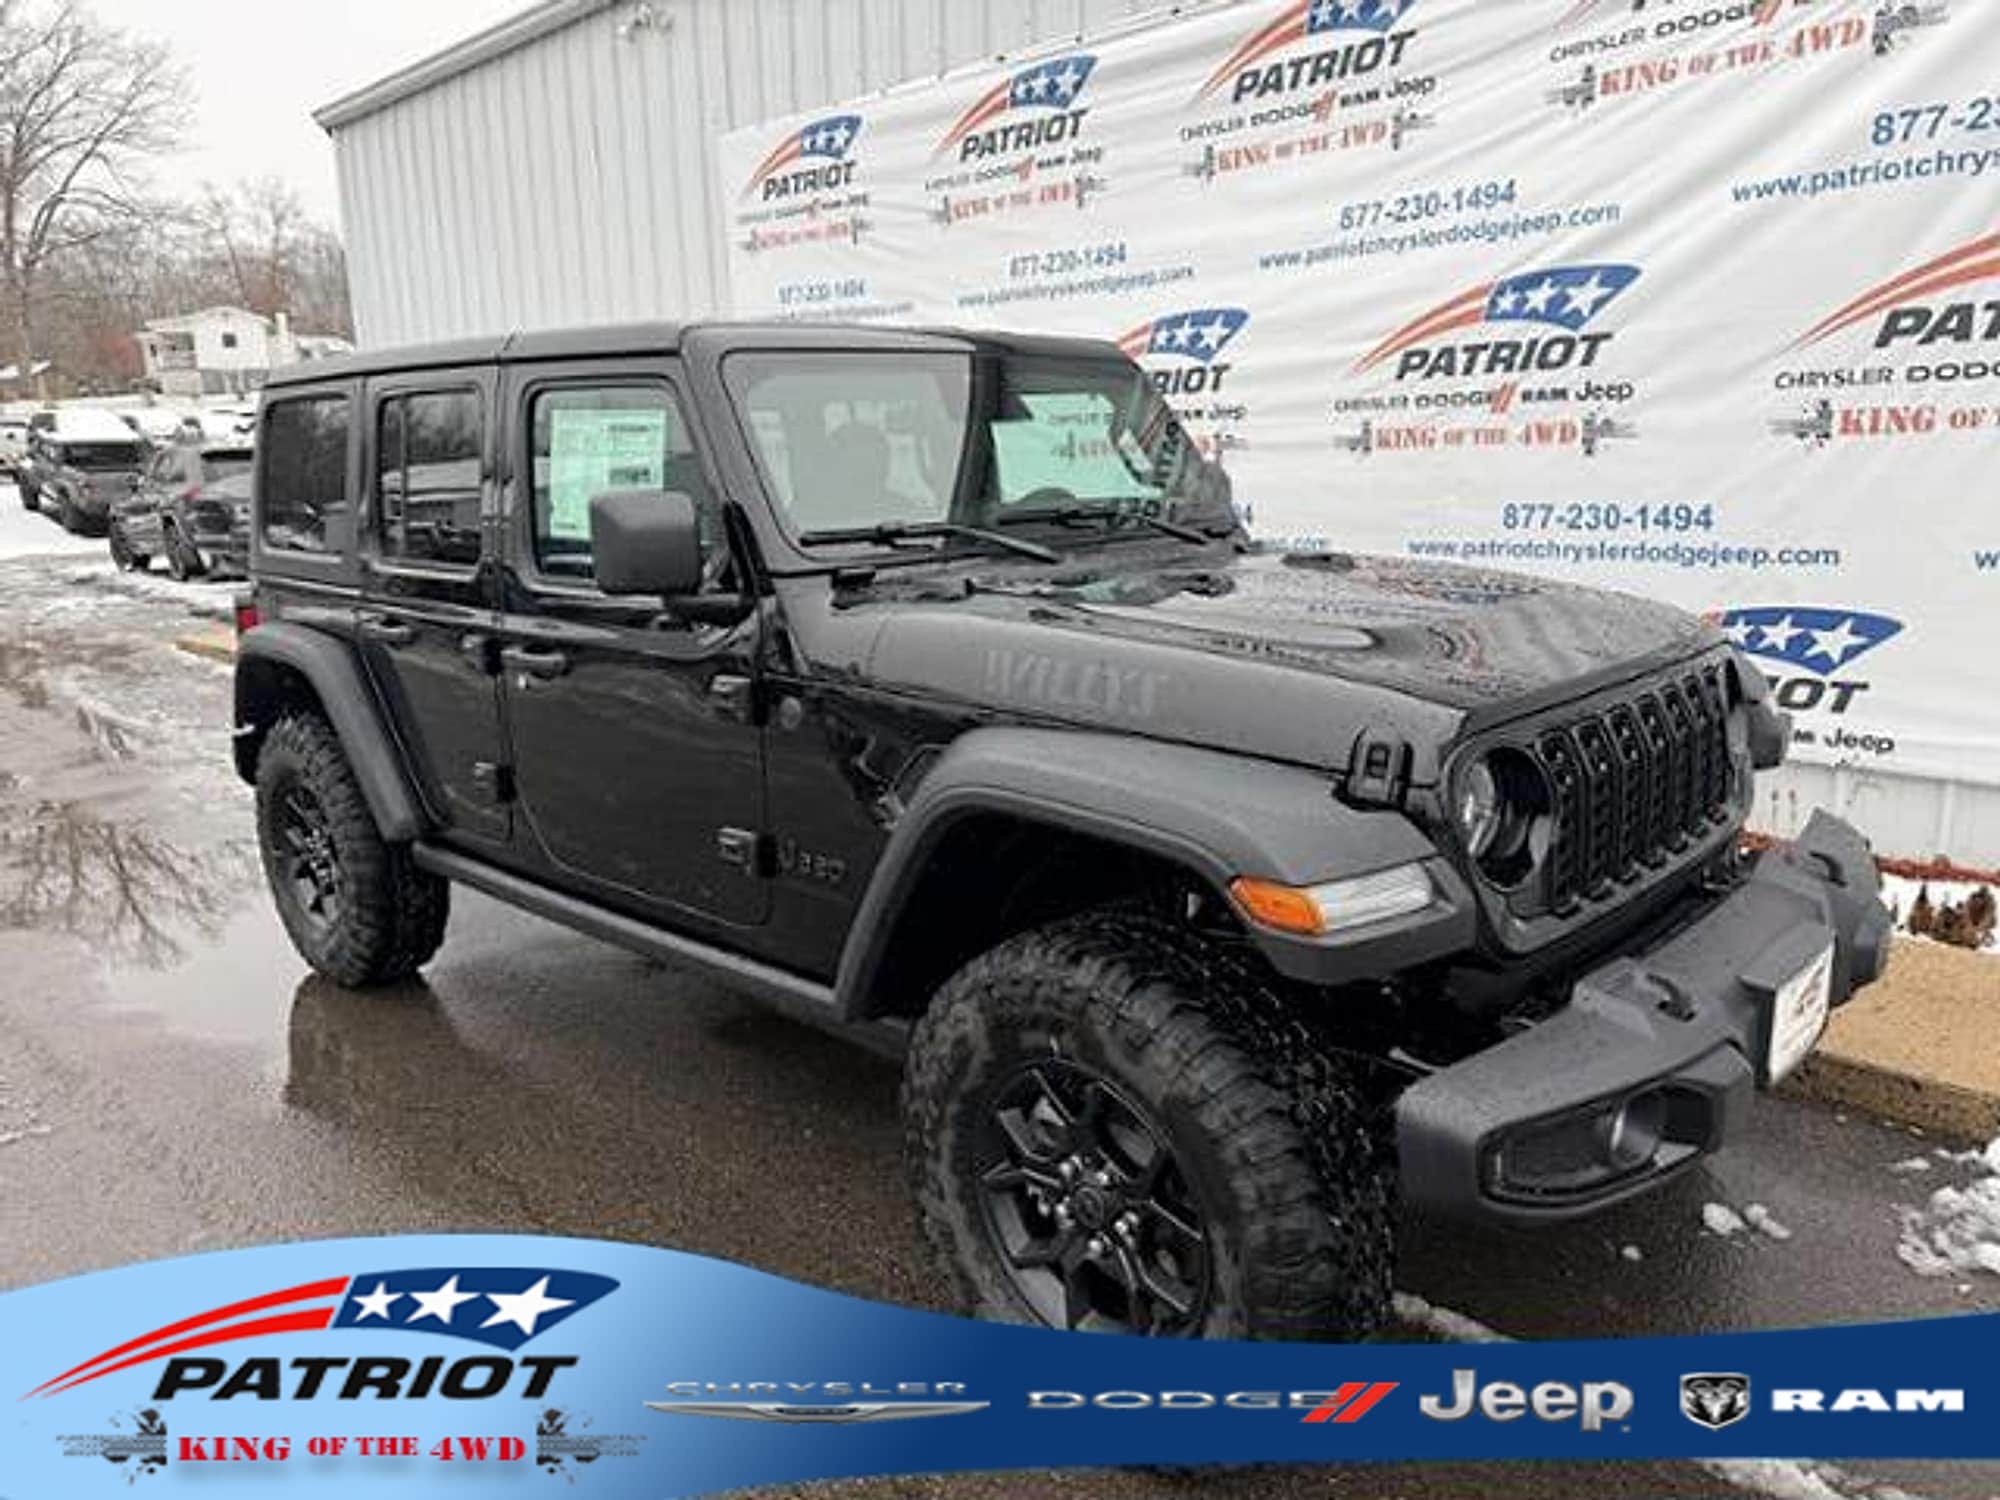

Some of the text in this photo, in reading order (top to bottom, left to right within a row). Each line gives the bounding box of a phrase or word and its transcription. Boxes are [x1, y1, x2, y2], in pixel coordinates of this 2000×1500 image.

[1231, 29, 1418, 103] PATRIOT
[1600, 57, 1678, 95] KING
[960, 108, 1091, 163] PATRIOT
[763, 161, 858, 201] PATRIOT
[1338, 179, 1518, 231] 877-230-1494
[1396, 332, 1613, 380] PATRIOT
[1575, 380, 1634, 404] Jeep
[1774, 366, 1895, 389] CHRYSLER
[1376, 426, 1437, 450] KING
[1838, 406, 1937, 436] KING
[1502, 503, 1714, 531] 877-230-1494
[1824, 728, 1895, 755] Jeep
